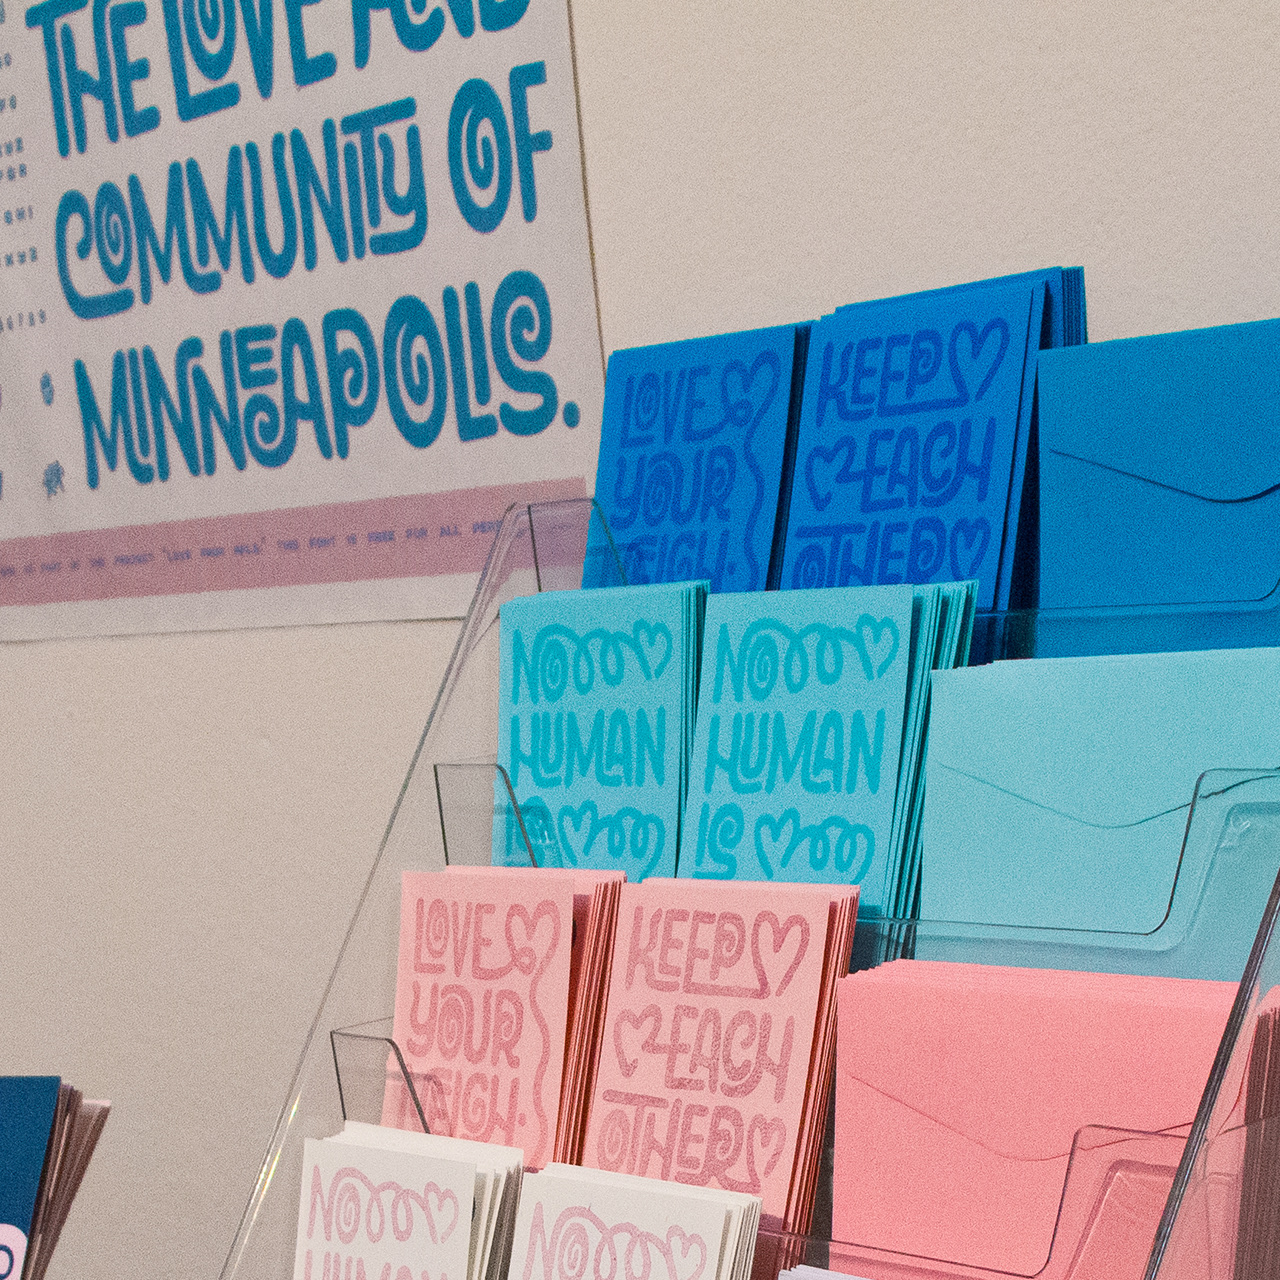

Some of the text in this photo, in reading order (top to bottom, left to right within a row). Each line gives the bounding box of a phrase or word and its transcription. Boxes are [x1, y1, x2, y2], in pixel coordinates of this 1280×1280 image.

[24, 0, 161, 158] THE
[164, 0, 337, 123] LOVE
[55, 97, 429, 320] COMMUNITY
[447, 60, 553, 234] OF
[73, 270, 581, 491] MINNEAPOLIS.
[620, 364, 718, 449] LOVE
[816, 329, 943, 428] KEEP
[610, 445, 737, 530] YOUR
[859, 416, 997, 514] EACH
[510, 705, 667, 789] HUMAN
[704, 708, 886, 796] HUMAN
[692, 801, 745, 880] IS
[413, 897, 507, 980] LOVE
[625, 904, 747, 997] KEEP
[406, 980, 525, 1069] YOUR
[664, 1003, 796, 1104] EACH
[596, 1089, 752, 1191] OTHER
